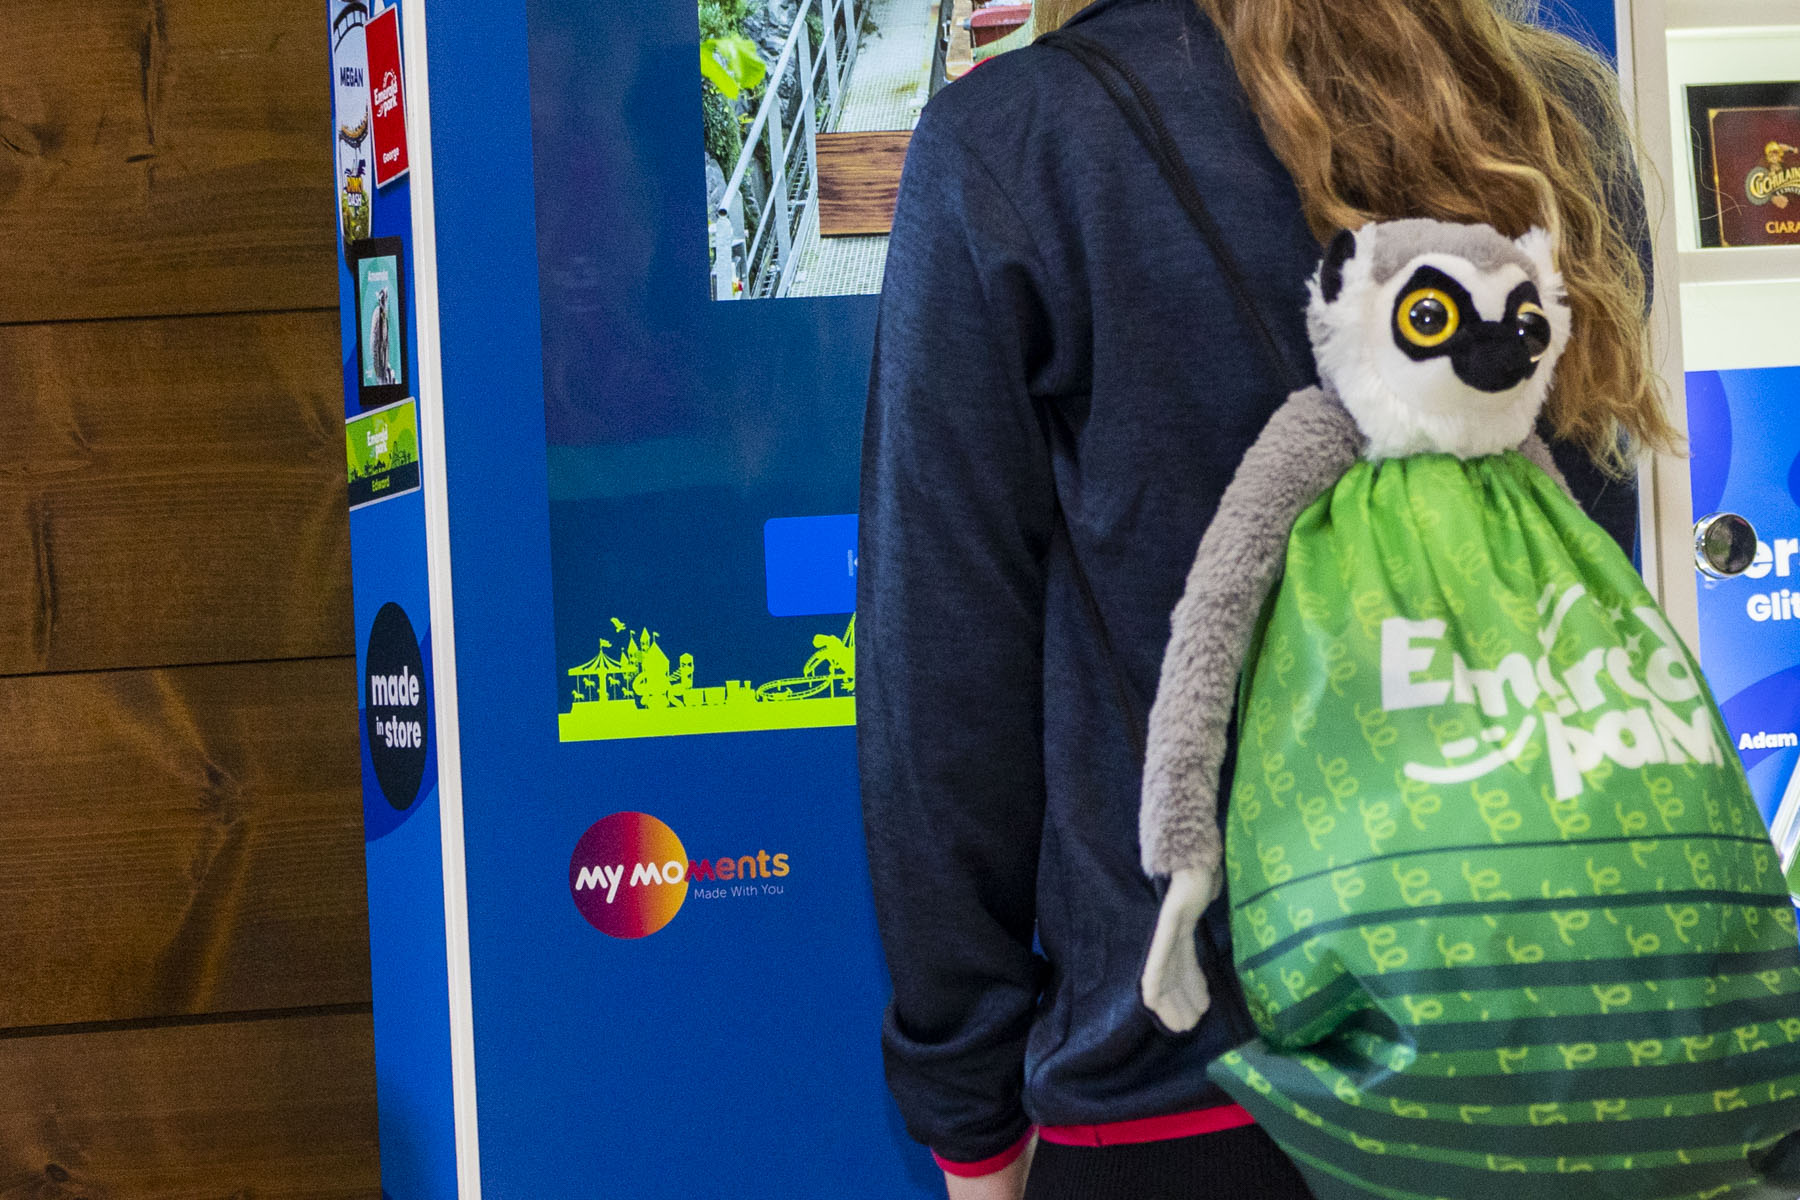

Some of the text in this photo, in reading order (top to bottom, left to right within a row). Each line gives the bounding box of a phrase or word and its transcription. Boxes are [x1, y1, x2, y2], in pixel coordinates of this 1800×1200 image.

[371, 665, 420, 707] made
[376, 715, 422, 748] in store
[1738, 730, 1798, 750] Adam
[694, 883, 784, 900] Made With You
